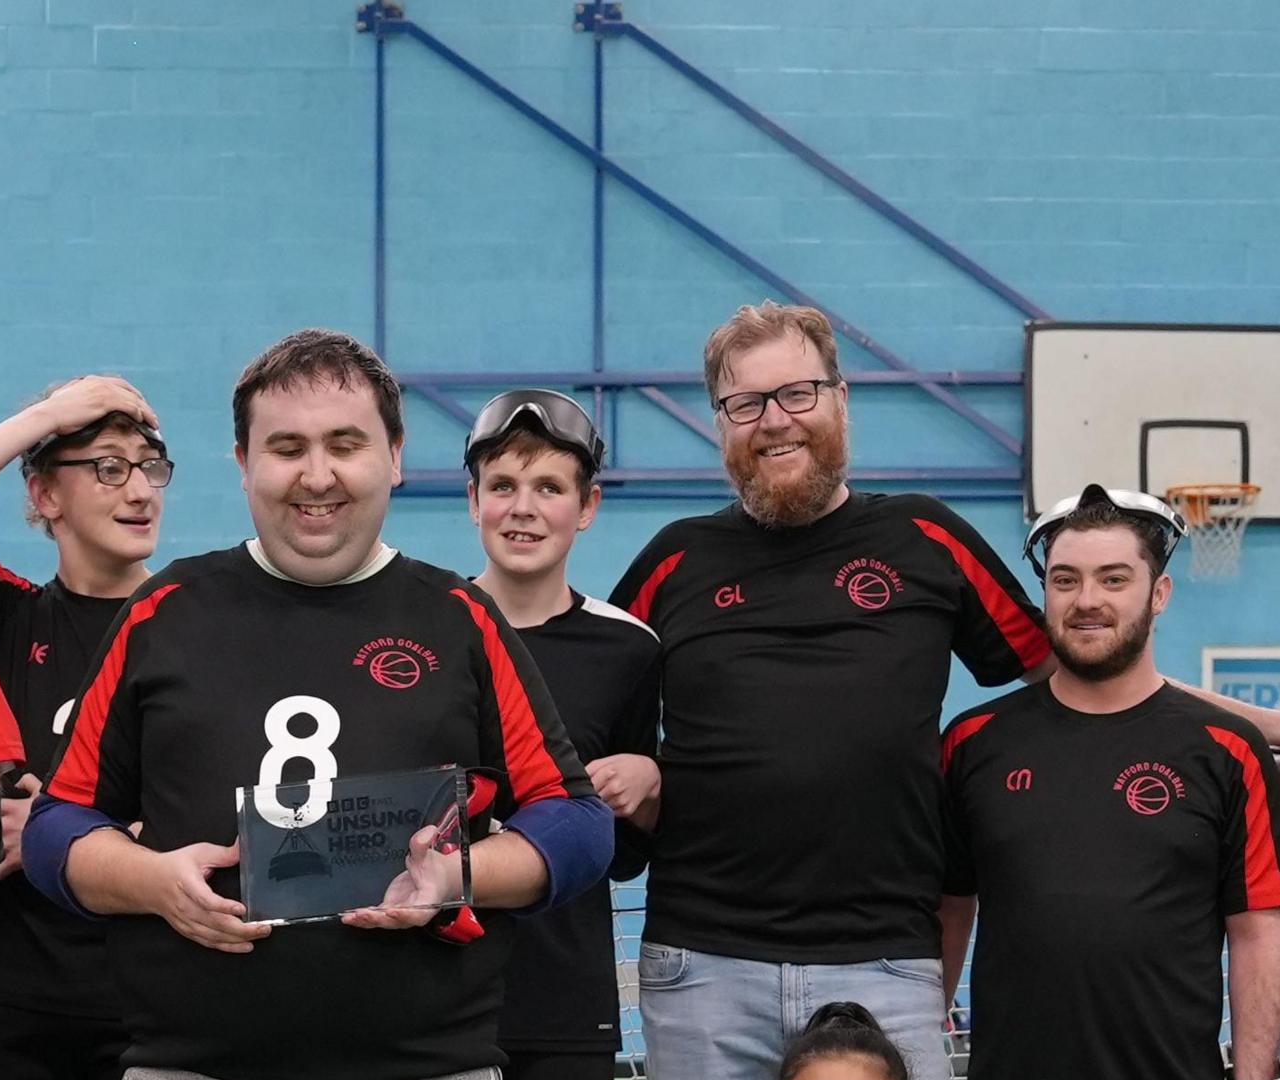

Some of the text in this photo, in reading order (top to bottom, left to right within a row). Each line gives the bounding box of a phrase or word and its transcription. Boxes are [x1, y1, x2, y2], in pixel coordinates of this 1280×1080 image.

[834, 558, 904, 592] WATFORD GOALBALL
[715, 584, 745, 607] GL
[352, 638, 440, 672] WATFORD GOALBALL
[253, 695, 341, 829] 8
[1113, 762, 1186, 799] WATFORD GOALBALL
[326, 809, 423, 832] UNSUNG
[327, 831, 386, 853] HERO
